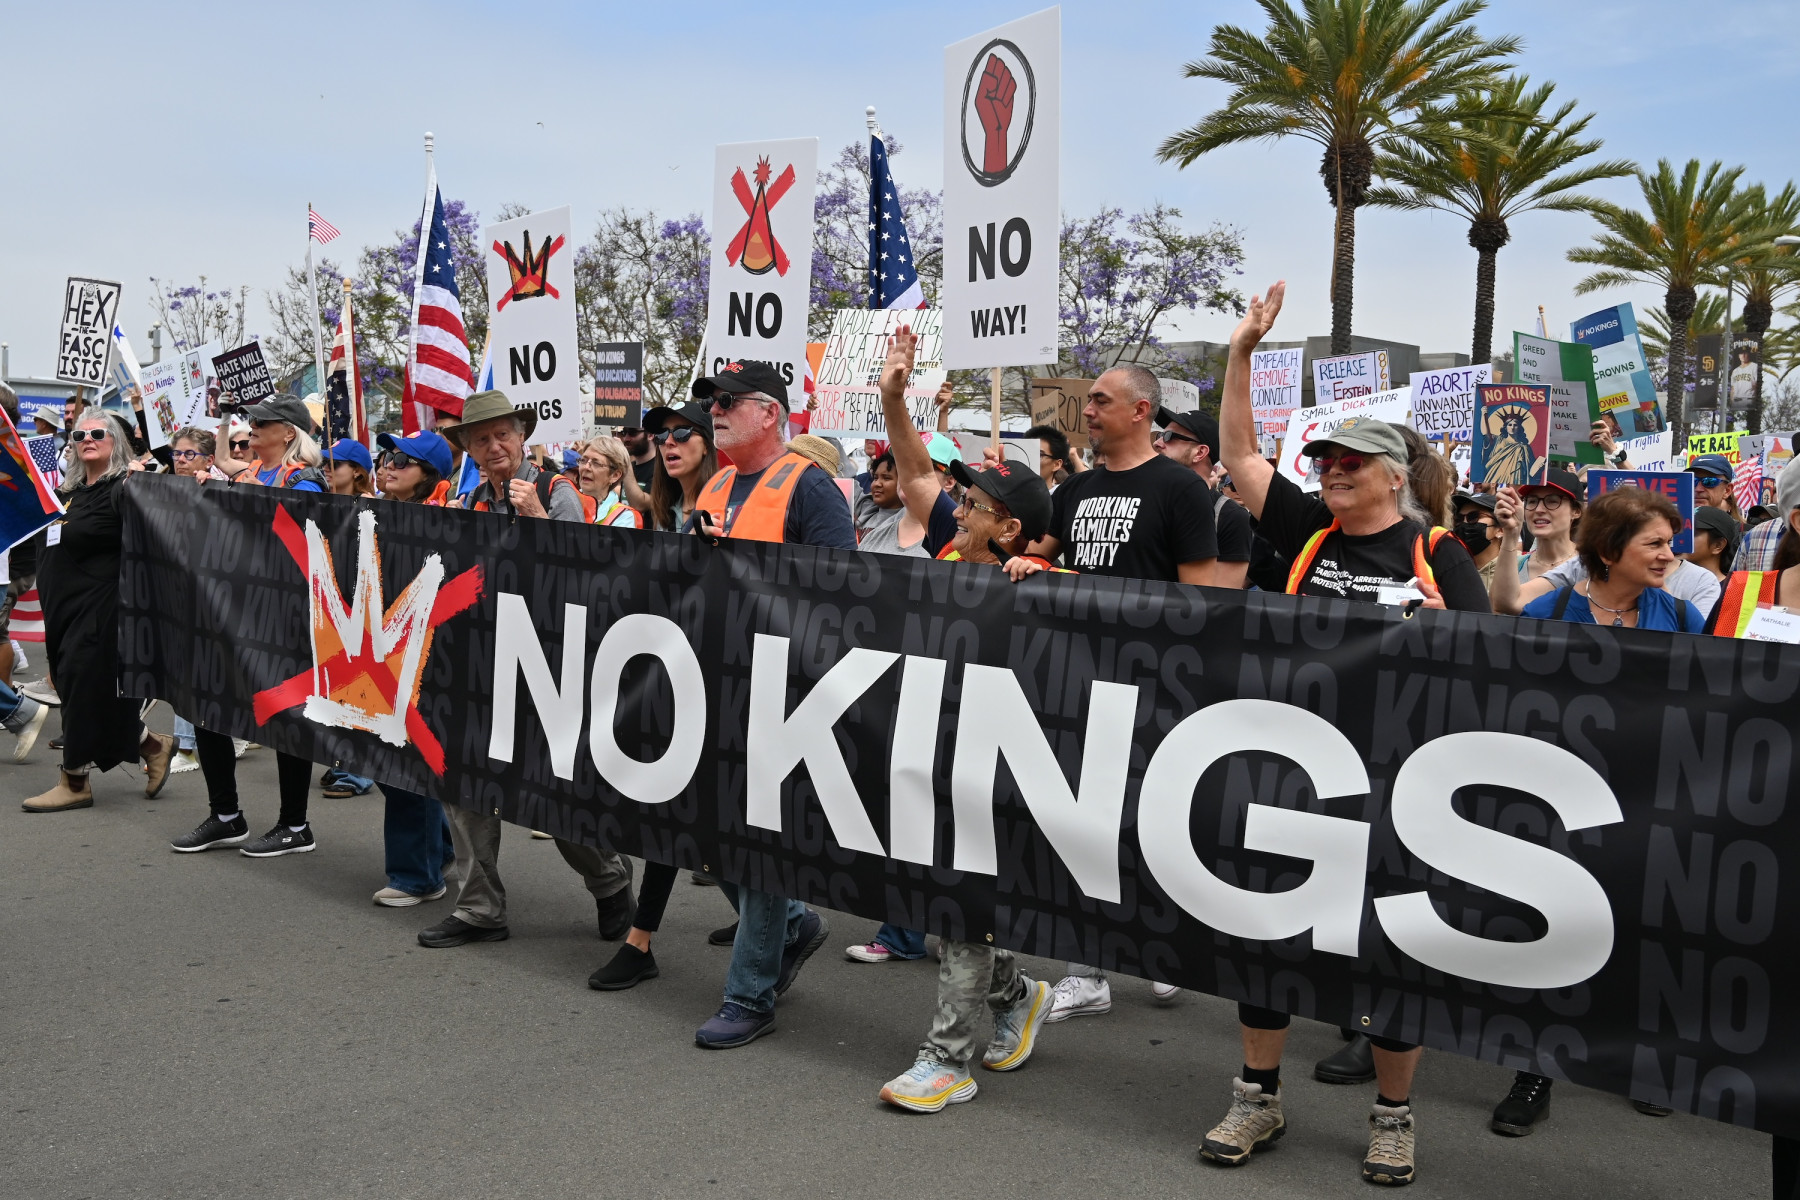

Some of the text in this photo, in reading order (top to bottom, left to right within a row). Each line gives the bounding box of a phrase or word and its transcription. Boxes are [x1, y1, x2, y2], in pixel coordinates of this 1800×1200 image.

[968, 217, 1031, 283] NO
[66, 285, 114, 329] HEX
[728, 292, 783, 339] NO
[910, 309, 942, 335] ILEG
[971, 304, 1026, 338] WAY!
[62, 333, 105, 359] FASC
[1522, 344, 1545, 355] GREED
[60, 356, 102, 380] ISTS
[216, 350, 262, 377] HATE WILL
[509, 341, 556, 386] NO
[1319, 358, 1367, 380] RELEASE
[1523, 358, 1537, 367] AND
[1594, 361, 1635, 380] CROWNS
[144, 375, 175, 393] NO Kings
[221, 365, 268, 392] NOT MAKE
[1421, 371, 1472, 395] ABORT
[1523, 372, 1540, 382] HATE
[241, 380, 271, 400] GREAT
[816, 390, 841, 408] STOP
[1251, 386, 1296, 407] CONVICT
[1320, 385, 1331, 396] The
[1485, 386, 1546, 403] NO KINGS
[1600, 394, 1628, 408] OWNS
[1254, 409, 1267, 418] THE
[1300, 406, 1335, 421] SMALL
[1415, 393, 1472, 413] UNWANTE
[810, 410, 845, 430] RACISM
[1415, 409, 1473, 431] PRESIDE
[1553, 411, 1577, 420] MAKE
[1263, 422, 1286, 434] FELON
[1690, 438, 1706, 453] WE
[1075, 497, 1141, 519] WORKING
[1071, 519, 1133, 542] FAMILIES
[1074, 543, 1119, 566] PARTY
[1653, 704, 1793, 827] NO
[488, 591, 707, 803] NO
[746, 631, 1625, 989] KINGS
[1641, 824, 1780, 945] NO
[1637, 939, 1770, 1054] NO
